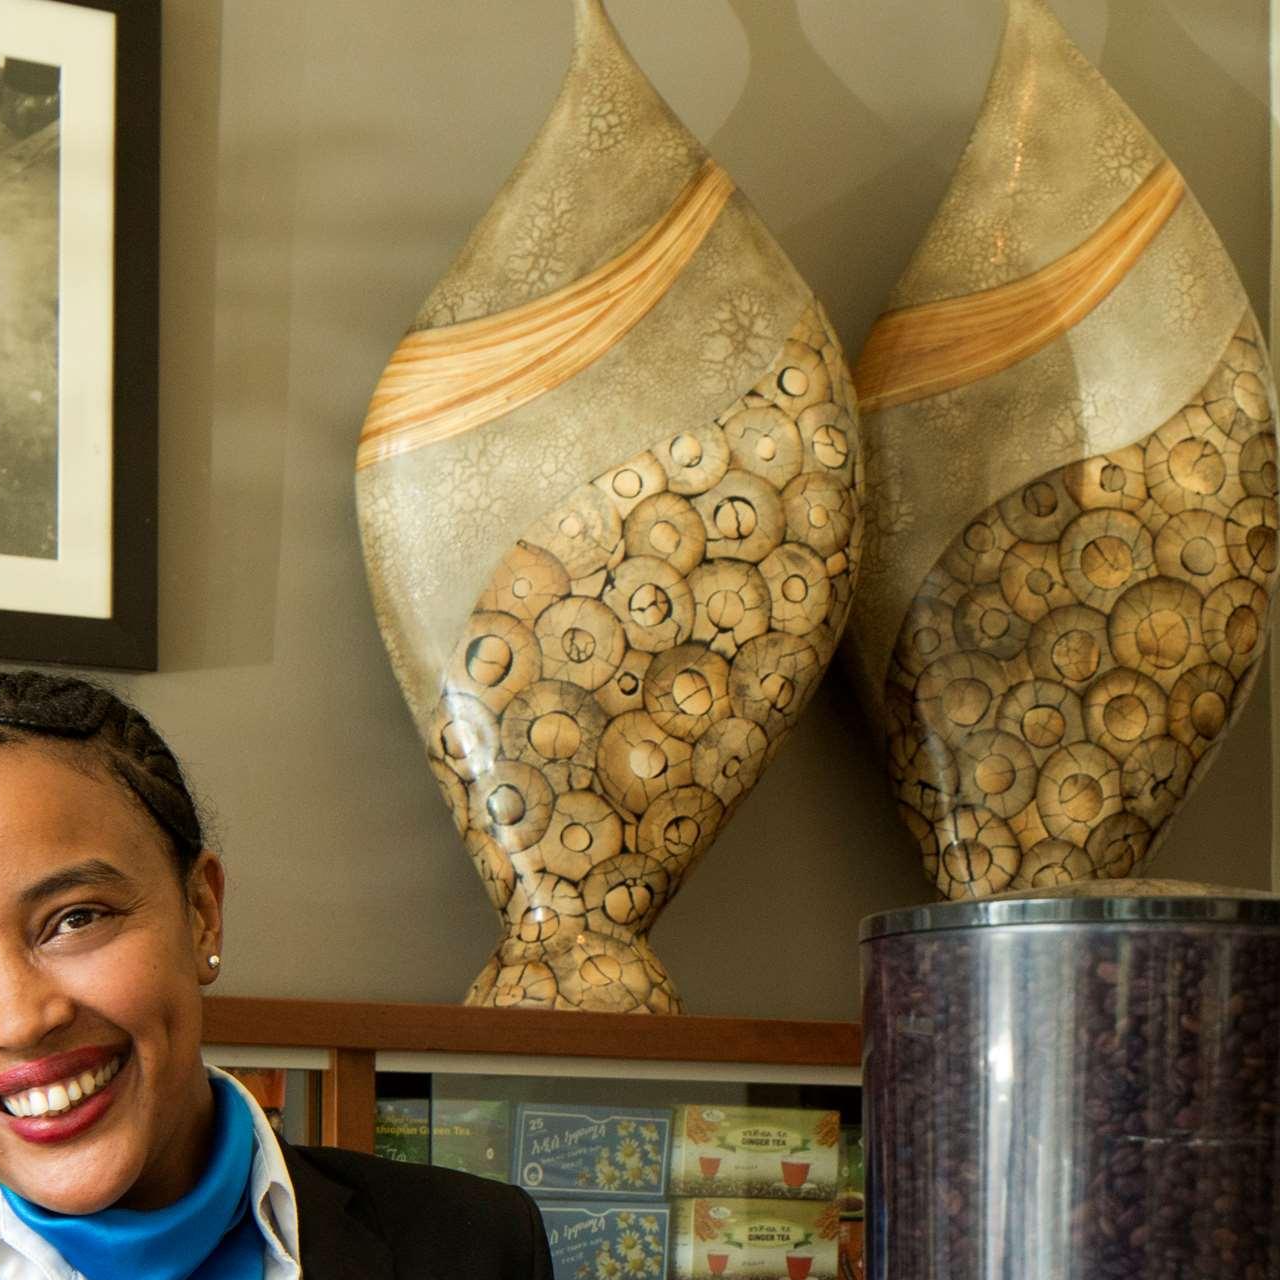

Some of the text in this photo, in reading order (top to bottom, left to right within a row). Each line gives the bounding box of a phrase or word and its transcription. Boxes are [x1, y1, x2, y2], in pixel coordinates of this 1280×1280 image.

[374, 1125, 417, 1137] thiopian
[419, 1126, 451, 1136] Geen
[772, 1138, 787, 1147] TEA
[777, 1234, 791, 1242] TEA
